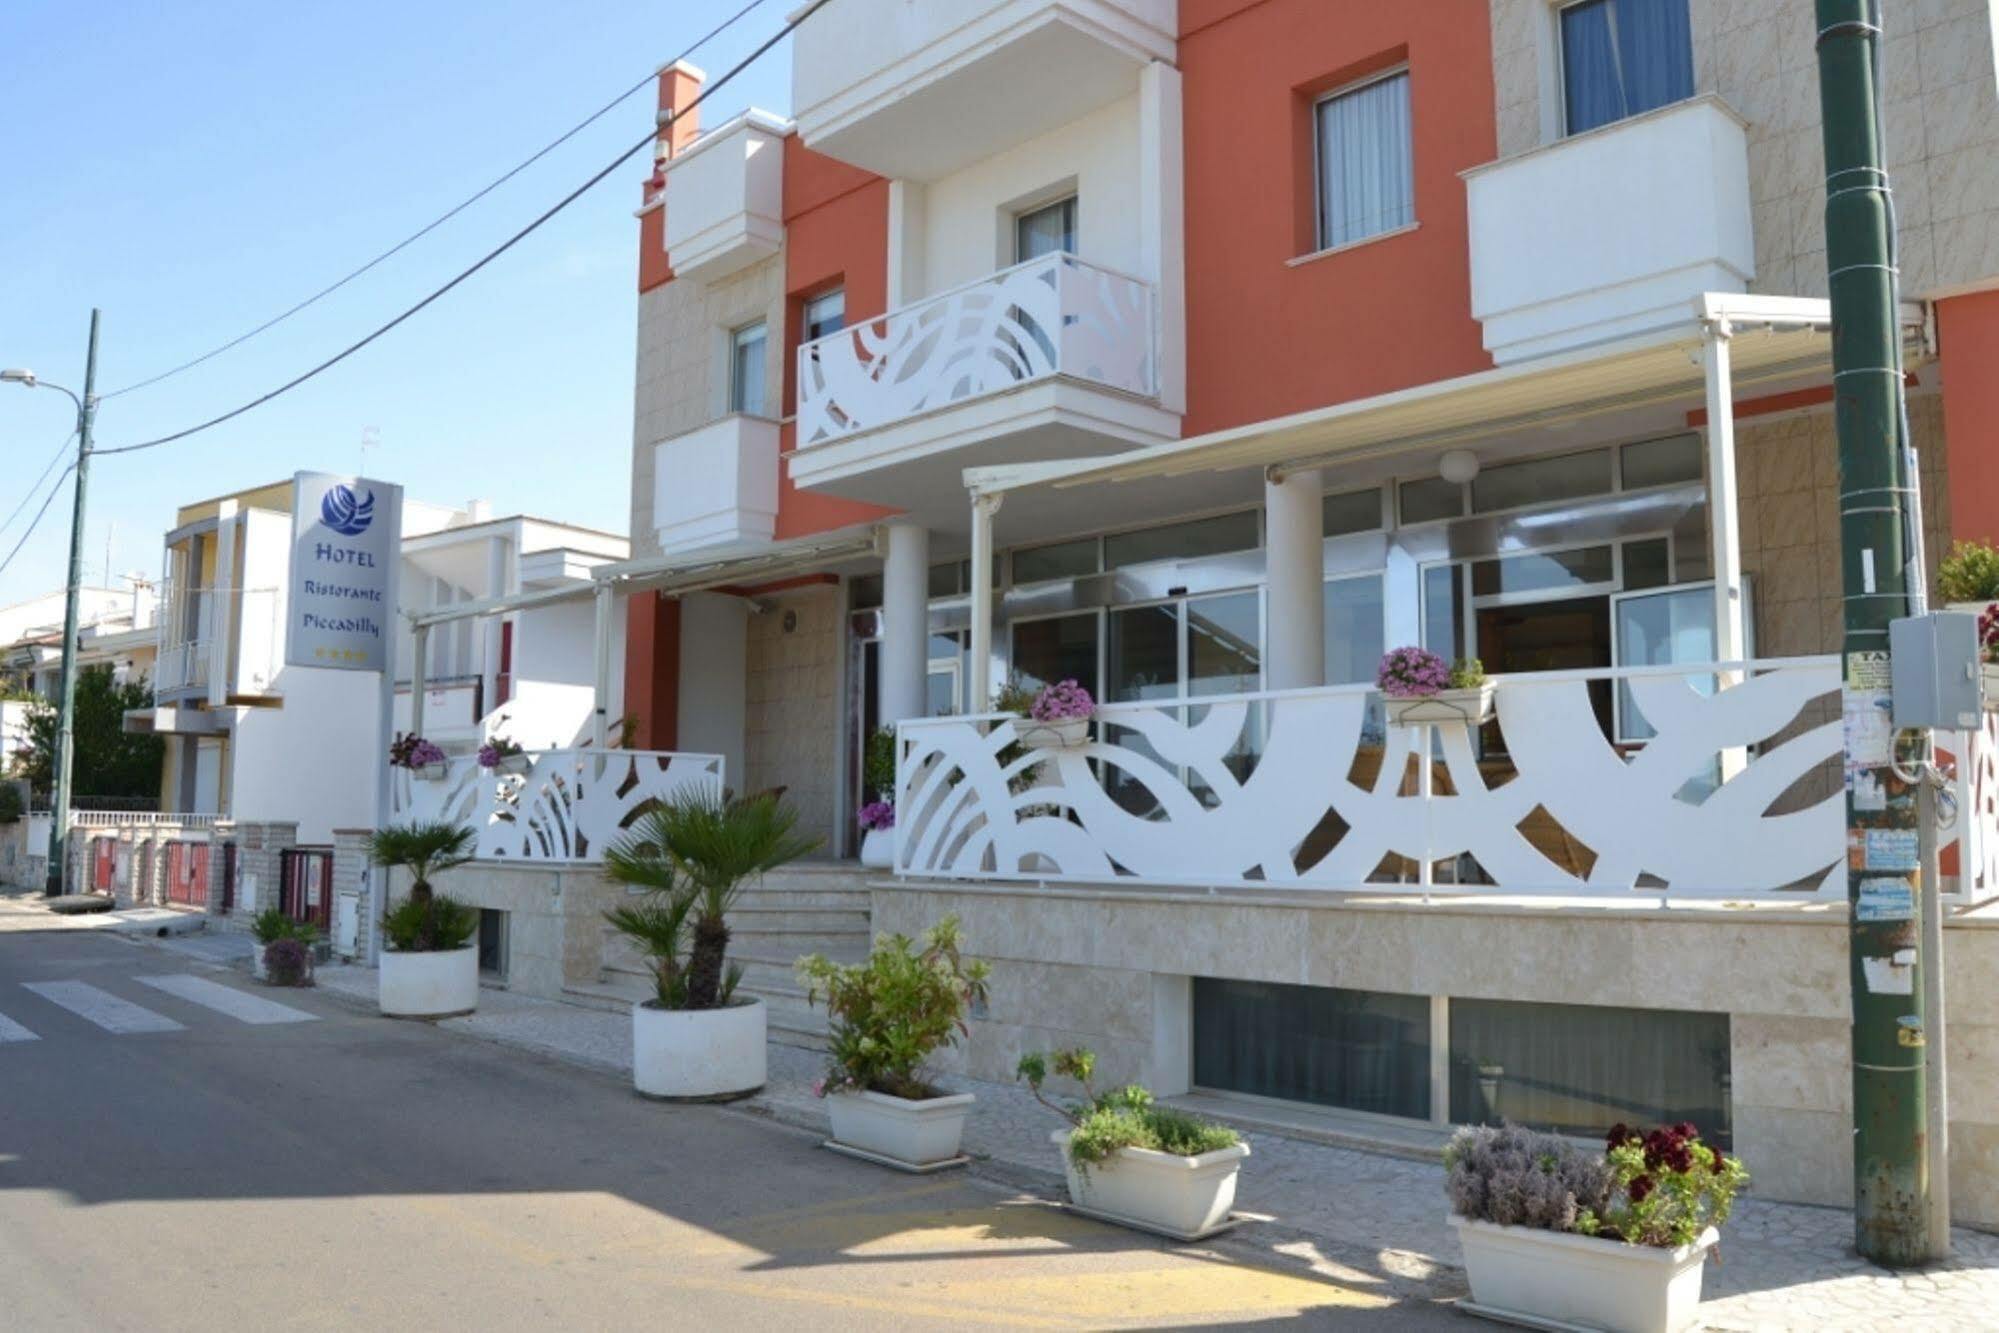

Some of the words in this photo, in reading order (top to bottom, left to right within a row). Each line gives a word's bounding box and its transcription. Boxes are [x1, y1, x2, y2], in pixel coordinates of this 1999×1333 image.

[316, 543, 375, 568] HOTEL
[304, 580, 382, 602] Ristorante
[303, 613, 379, 639] Piccadilly
